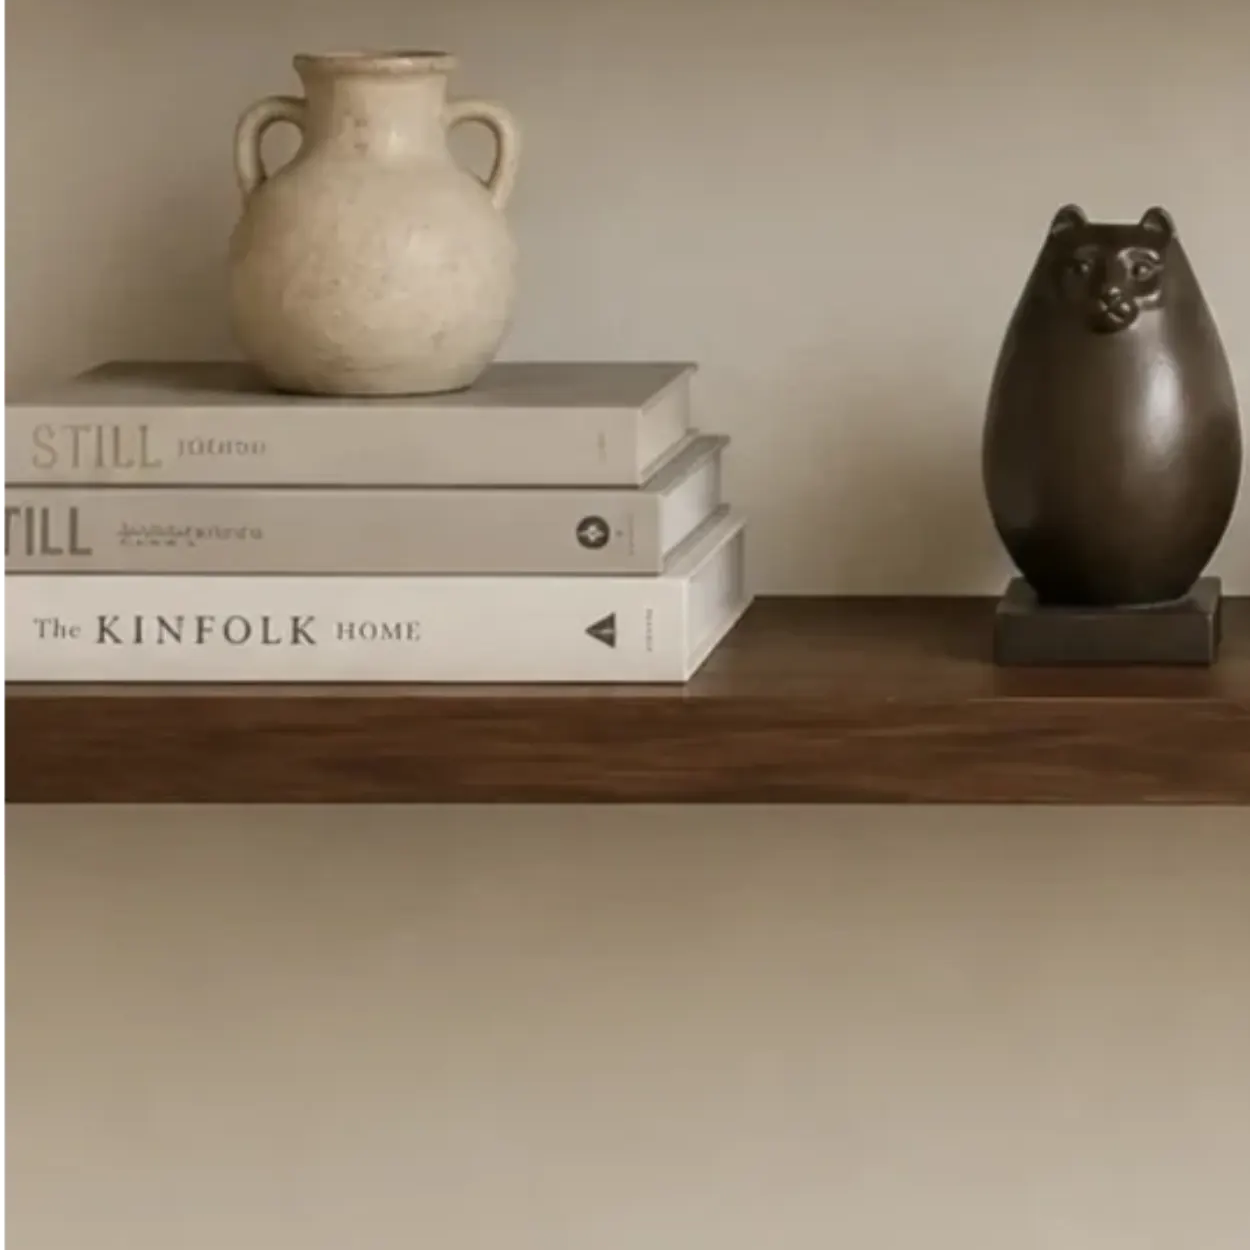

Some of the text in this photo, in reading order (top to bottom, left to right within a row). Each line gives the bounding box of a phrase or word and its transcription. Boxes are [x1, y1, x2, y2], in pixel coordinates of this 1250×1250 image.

[31, 423, 163, 469] STILL
[33, 614, 421, 646] The KINFOLK HOME
